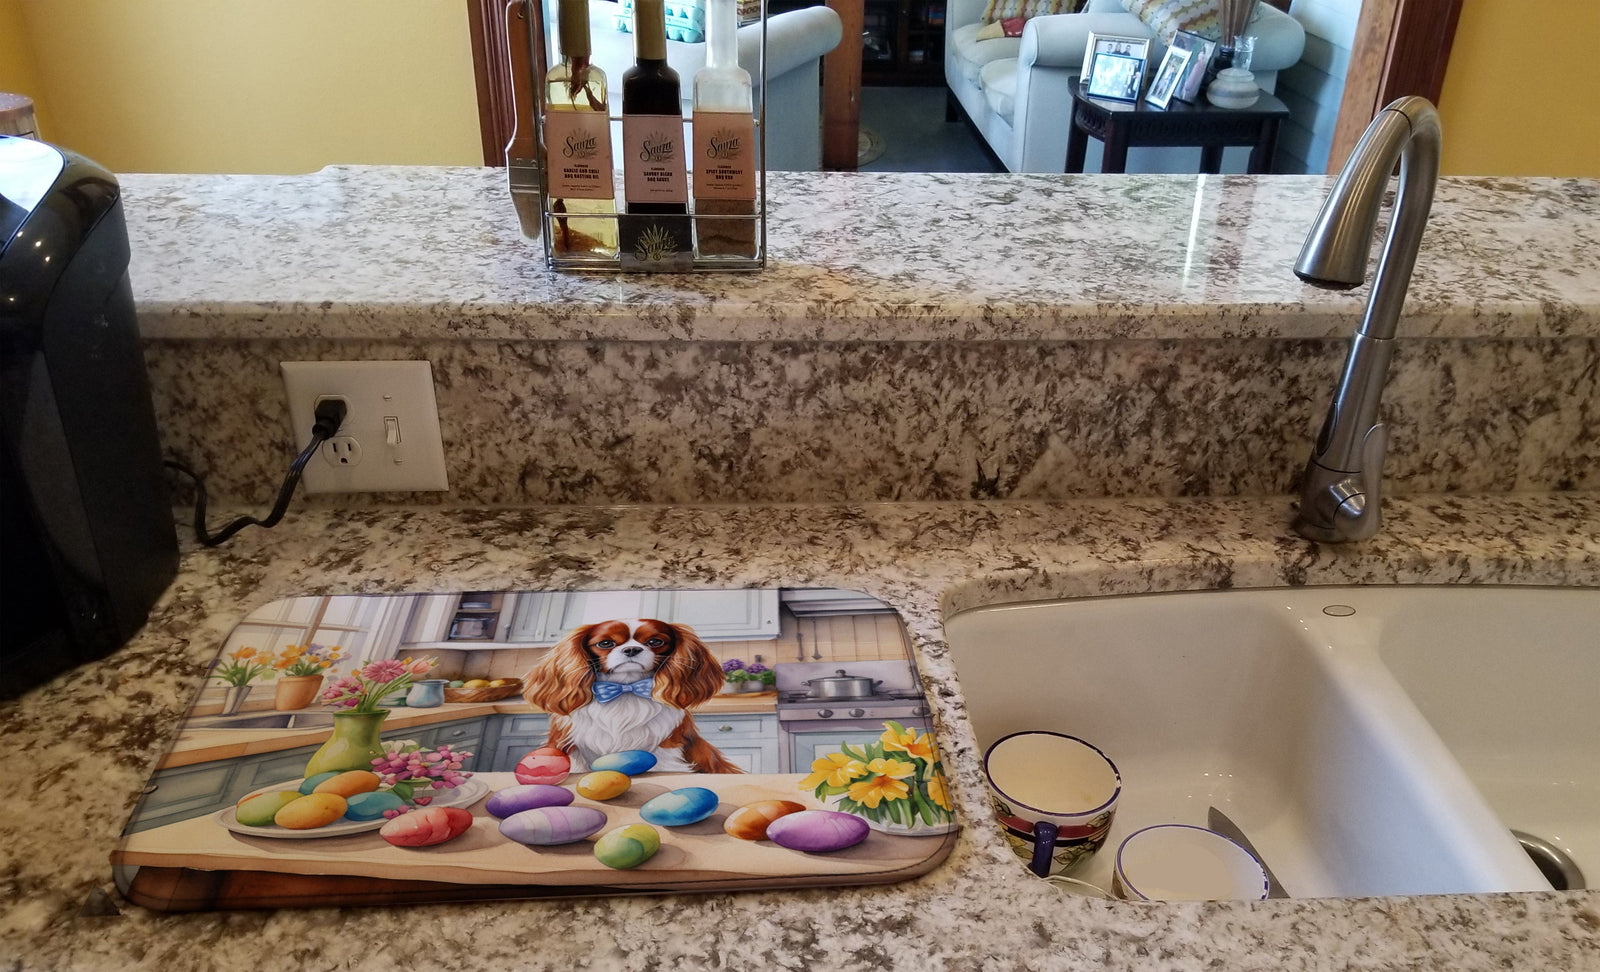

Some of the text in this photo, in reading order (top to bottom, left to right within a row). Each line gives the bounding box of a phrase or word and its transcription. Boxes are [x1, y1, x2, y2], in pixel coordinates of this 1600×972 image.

[563, 136, 597, 158] Sauza
[639, 139, 673, 162] Sauza
[706, 137, 740, 159] Sauza
